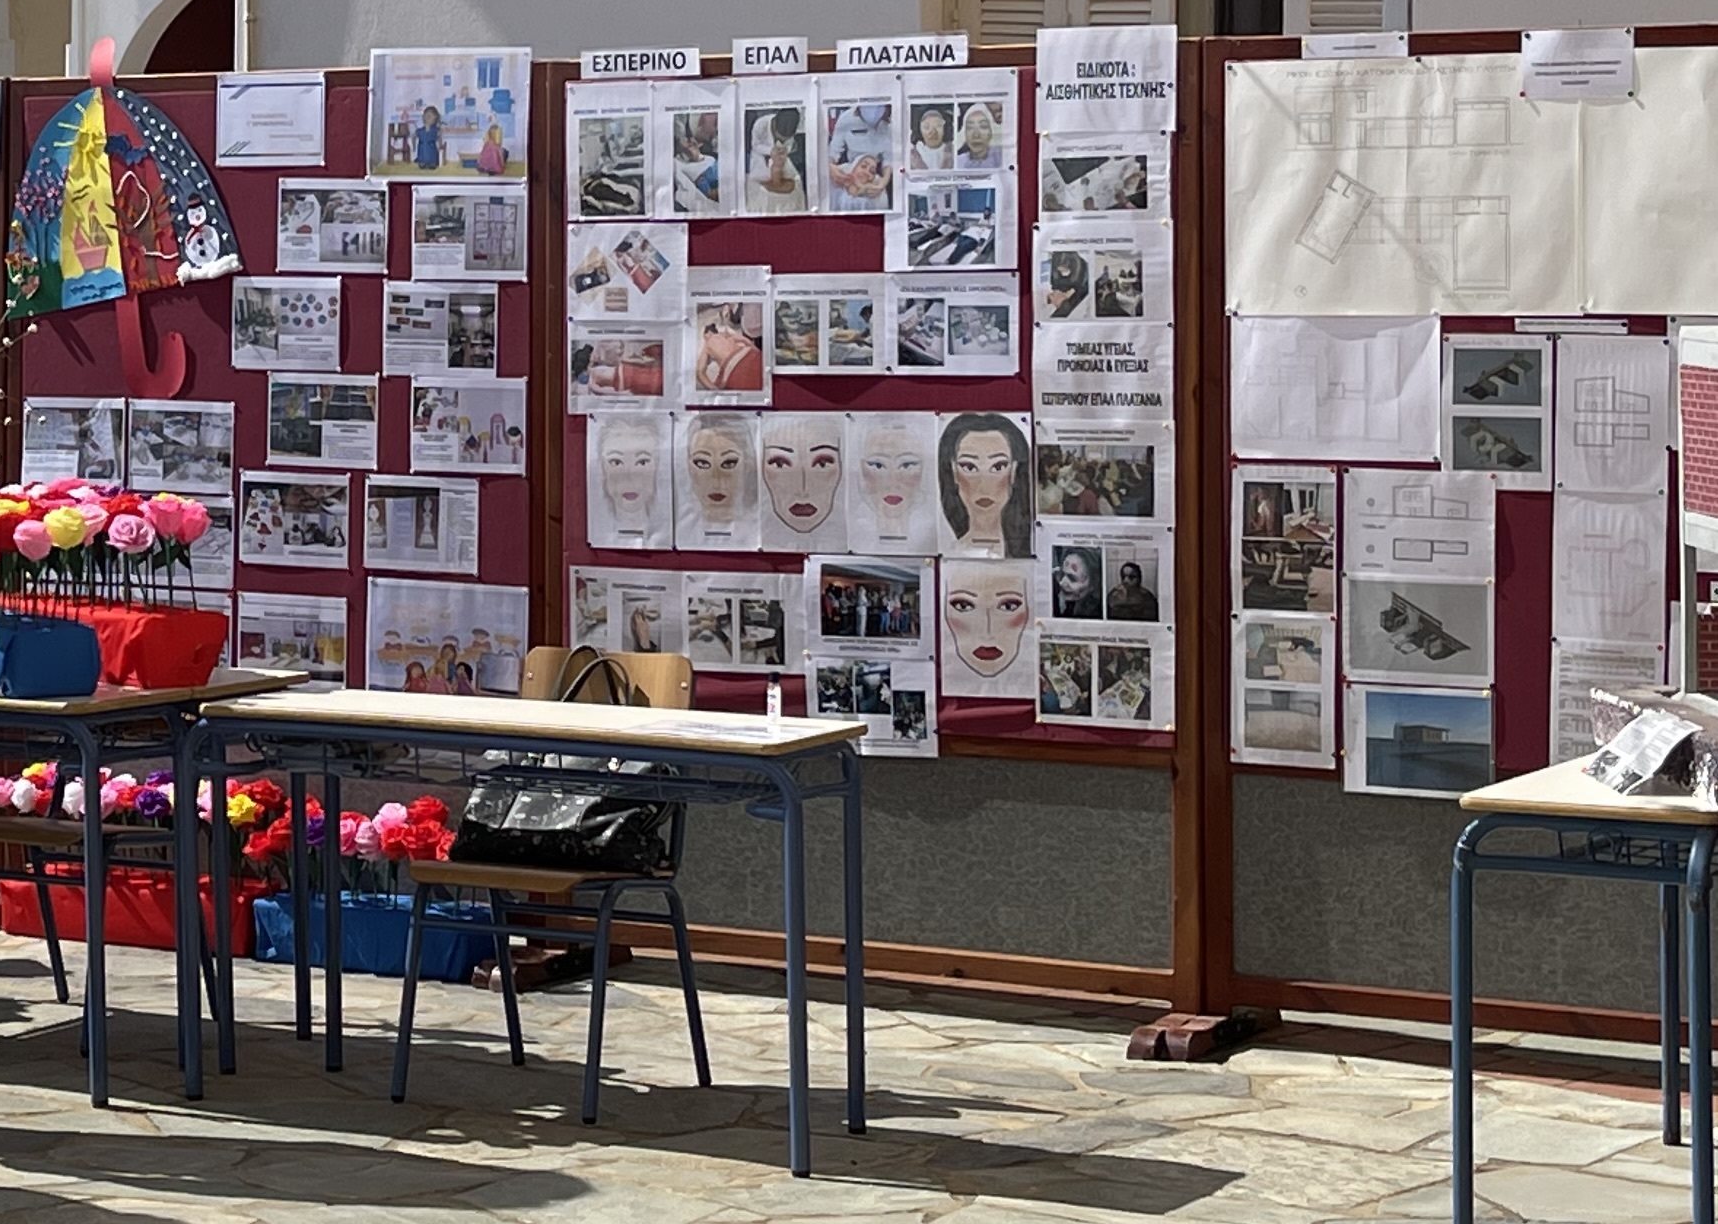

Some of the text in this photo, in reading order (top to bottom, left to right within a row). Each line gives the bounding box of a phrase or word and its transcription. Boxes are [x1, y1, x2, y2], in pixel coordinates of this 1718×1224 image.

[592, 43, 956, 73] ΕΣΠΕΡΙΝΟ ΕΠΑΛ ΠΛΑΤΑΝΙΑ
[1045, 81, 1167, 100] ΑΙΣΘΗΤΙΚΗΣ ΤΕΧΝΗΣ
[1090, 393, 1114, 406] ΕΠΑΛ
